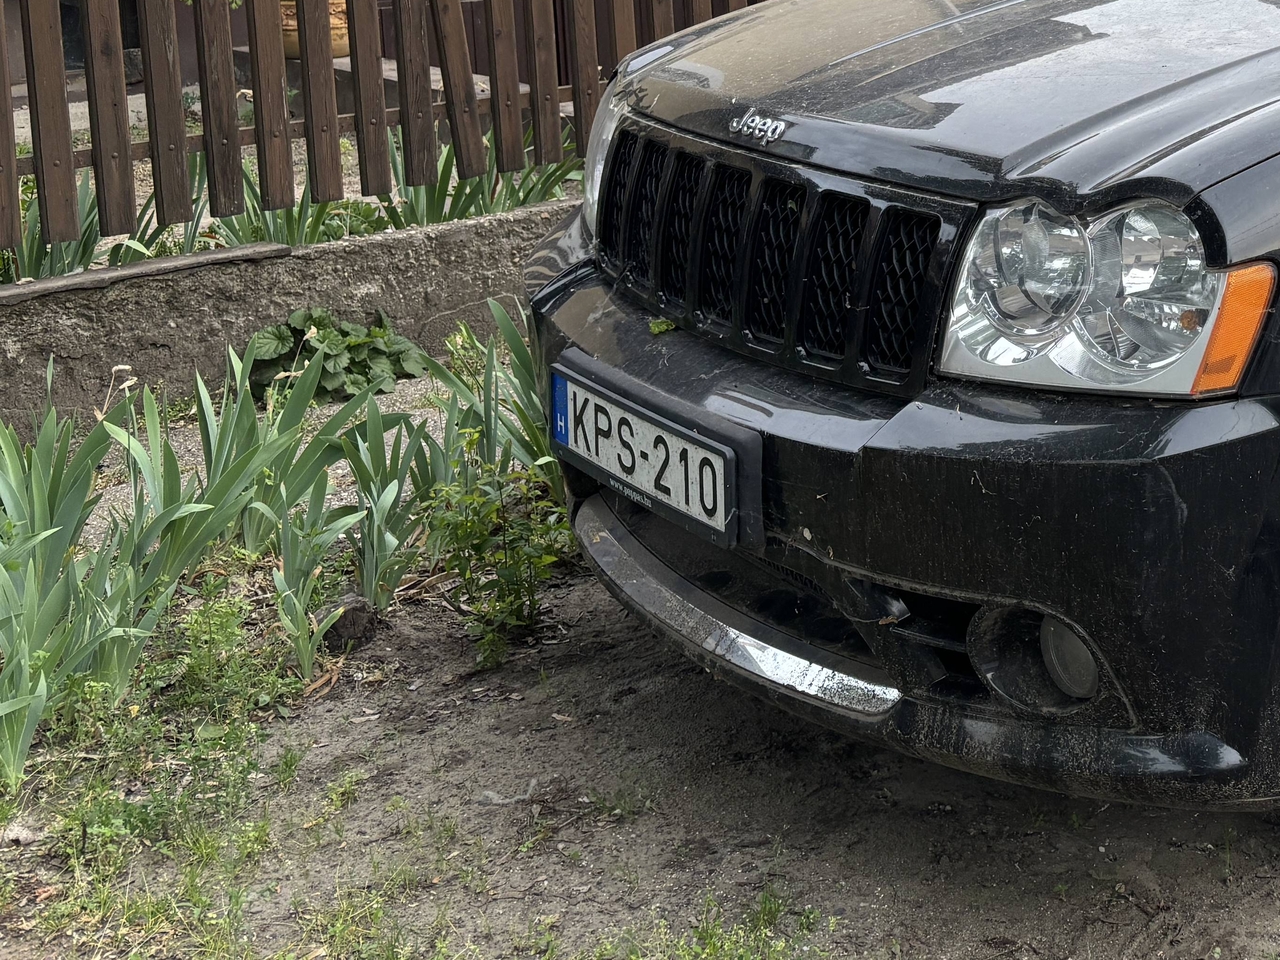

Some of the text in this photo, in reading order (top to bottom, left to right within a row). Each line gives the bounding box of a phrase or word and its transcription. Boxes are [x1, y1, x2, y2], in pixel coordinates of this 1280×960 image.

[729, 107, 786, 147] Jeep
[557, 413, 565, 434] H
[572, 390, 718, 518] KPS-210
